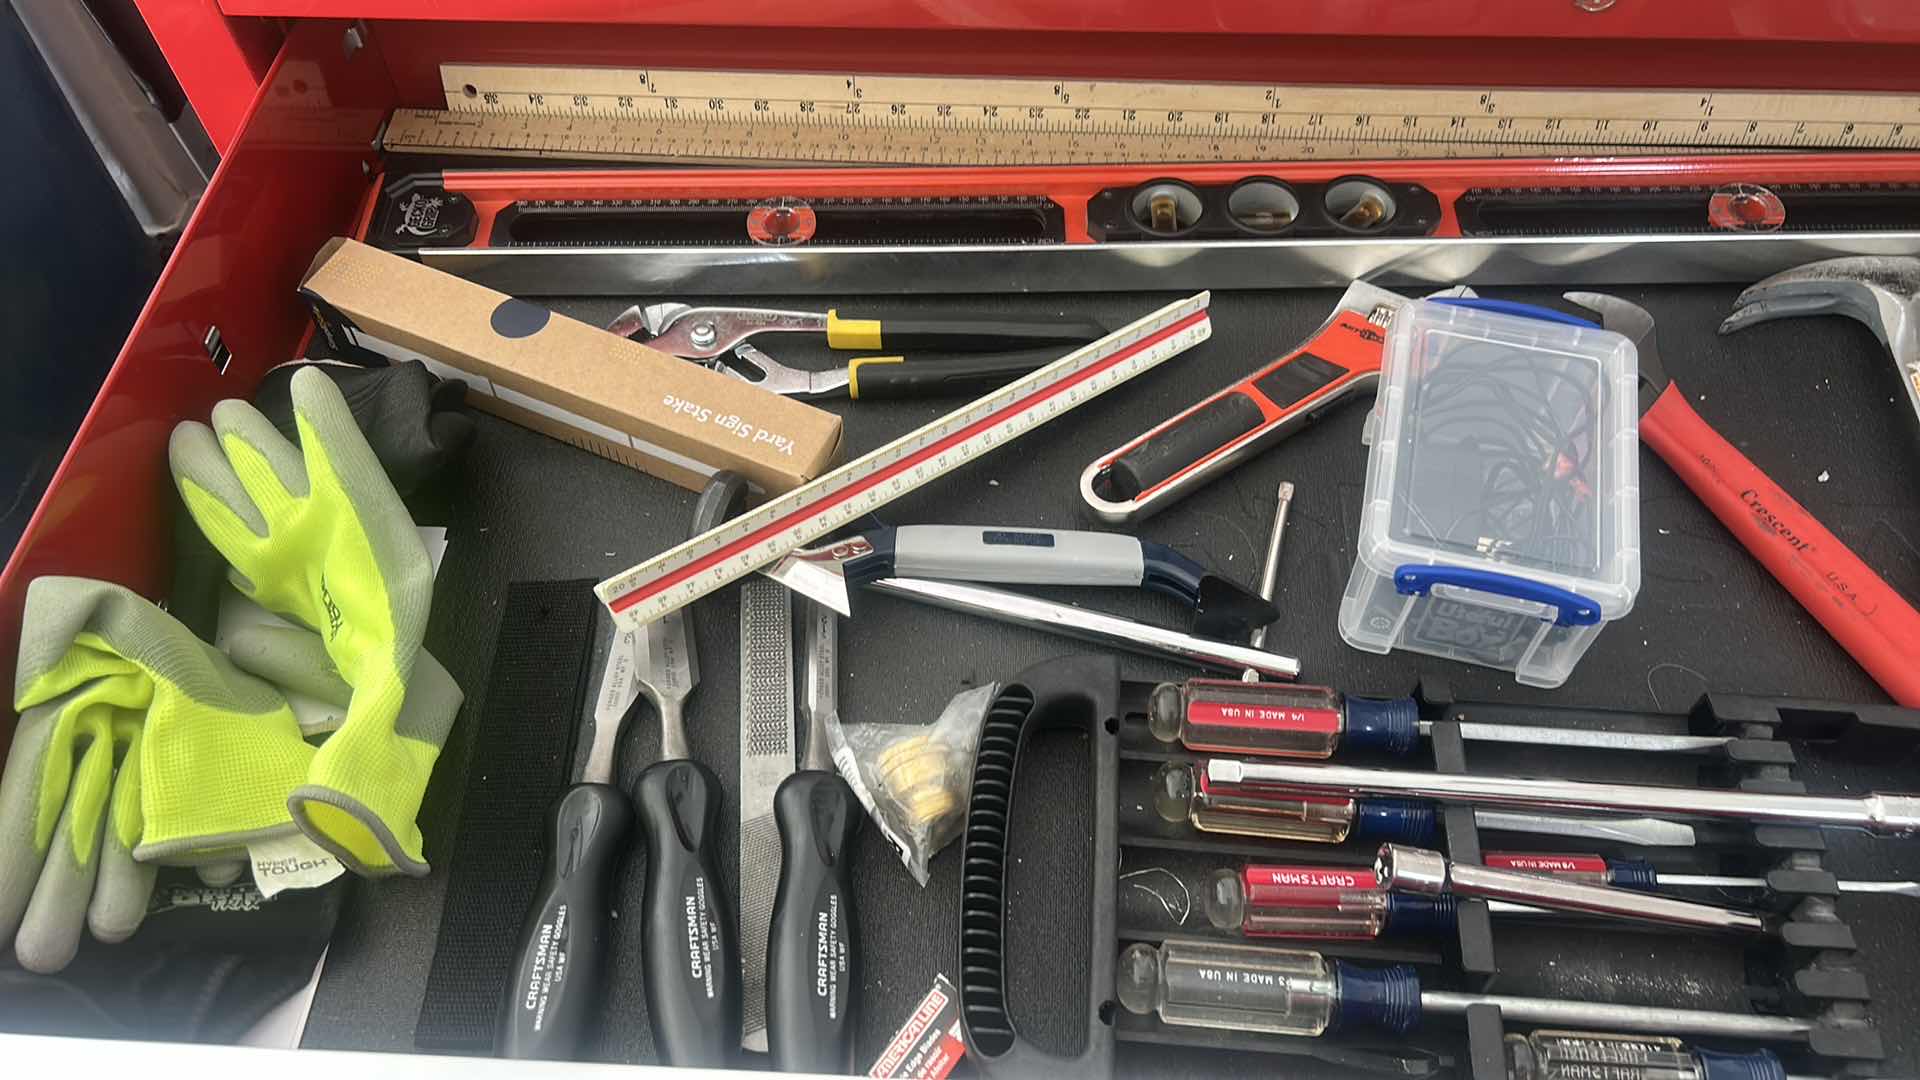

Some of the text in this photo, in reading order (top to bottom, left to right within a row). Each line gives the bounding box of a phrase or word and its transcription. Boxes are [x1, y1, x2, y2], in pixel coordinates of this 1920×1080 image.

[484, 94, 498, 104] 35
[528, 94, 544, 105] 34
[573, 95, 588, 106] 33
[618, 95, 633, 107] 32
[664, 98, 678, 109] 31
[709, 99, 724, 110] 30
[754, 100, 769, 111] 29
[800, 101, 814, 112] 28
[846, 102, 860, 113] 27
[891, 103, 906, 114] 26
[937, 104, 951, 115] 25
[983, 105, 998, 117] 24
[1029, 106, 1043, 118] 23
[1075, 108, 1090, 119] 22
[1122, 108, 1136, 120] 21
[1168, 110, 1183, 121] 20
[1214, 111, 1229, 123] 19
[1261, 113, 1276, 124] 18
[1308, 113, 1323, 125] 17
[1356, 114, 1370, 126] 16
[1403, 115, 1418, 127] 15
[1451, 116, 1466, 128] 14
[1498, 117, 1513, 129] 13
[1545, 119, 1561, 129] 12
[1595, 119, 1609, 130] 11
[1643, 120, 1658, 130] 10
[1700, 121, 1709, 132] 9
[1749, 122, 1757, 133] 8
[1797, 122, 1805, 134] 7
[1845, 124, 1854, 135] 6
[663, 394, 795, 455] Yard Sign Stake
[1740, 489, 1809, 551] Crescent
[1221, 707, 1305, 721] 1/4 MADE IN USA
[258, 858, 331, 877] TOUGH
[1272, 872, 1355, 887] CRAFTSMAN
[1538, 860, 1562, 869] MADE
[686, 896, 702, 979] CRAFTSMAN
[525, 924, 553, 1010] CRAFTSMAN
[817, 911, 828, 997] CRAFTSMAN
[1199, 969, 1221, 980] USA
[1226, 971, 1238, 982] IN
[1243, 973, 1273, 985] MADE
[904, 1050, 925, 1073] Edge
[918, 1027, 942, 1054] Blades
